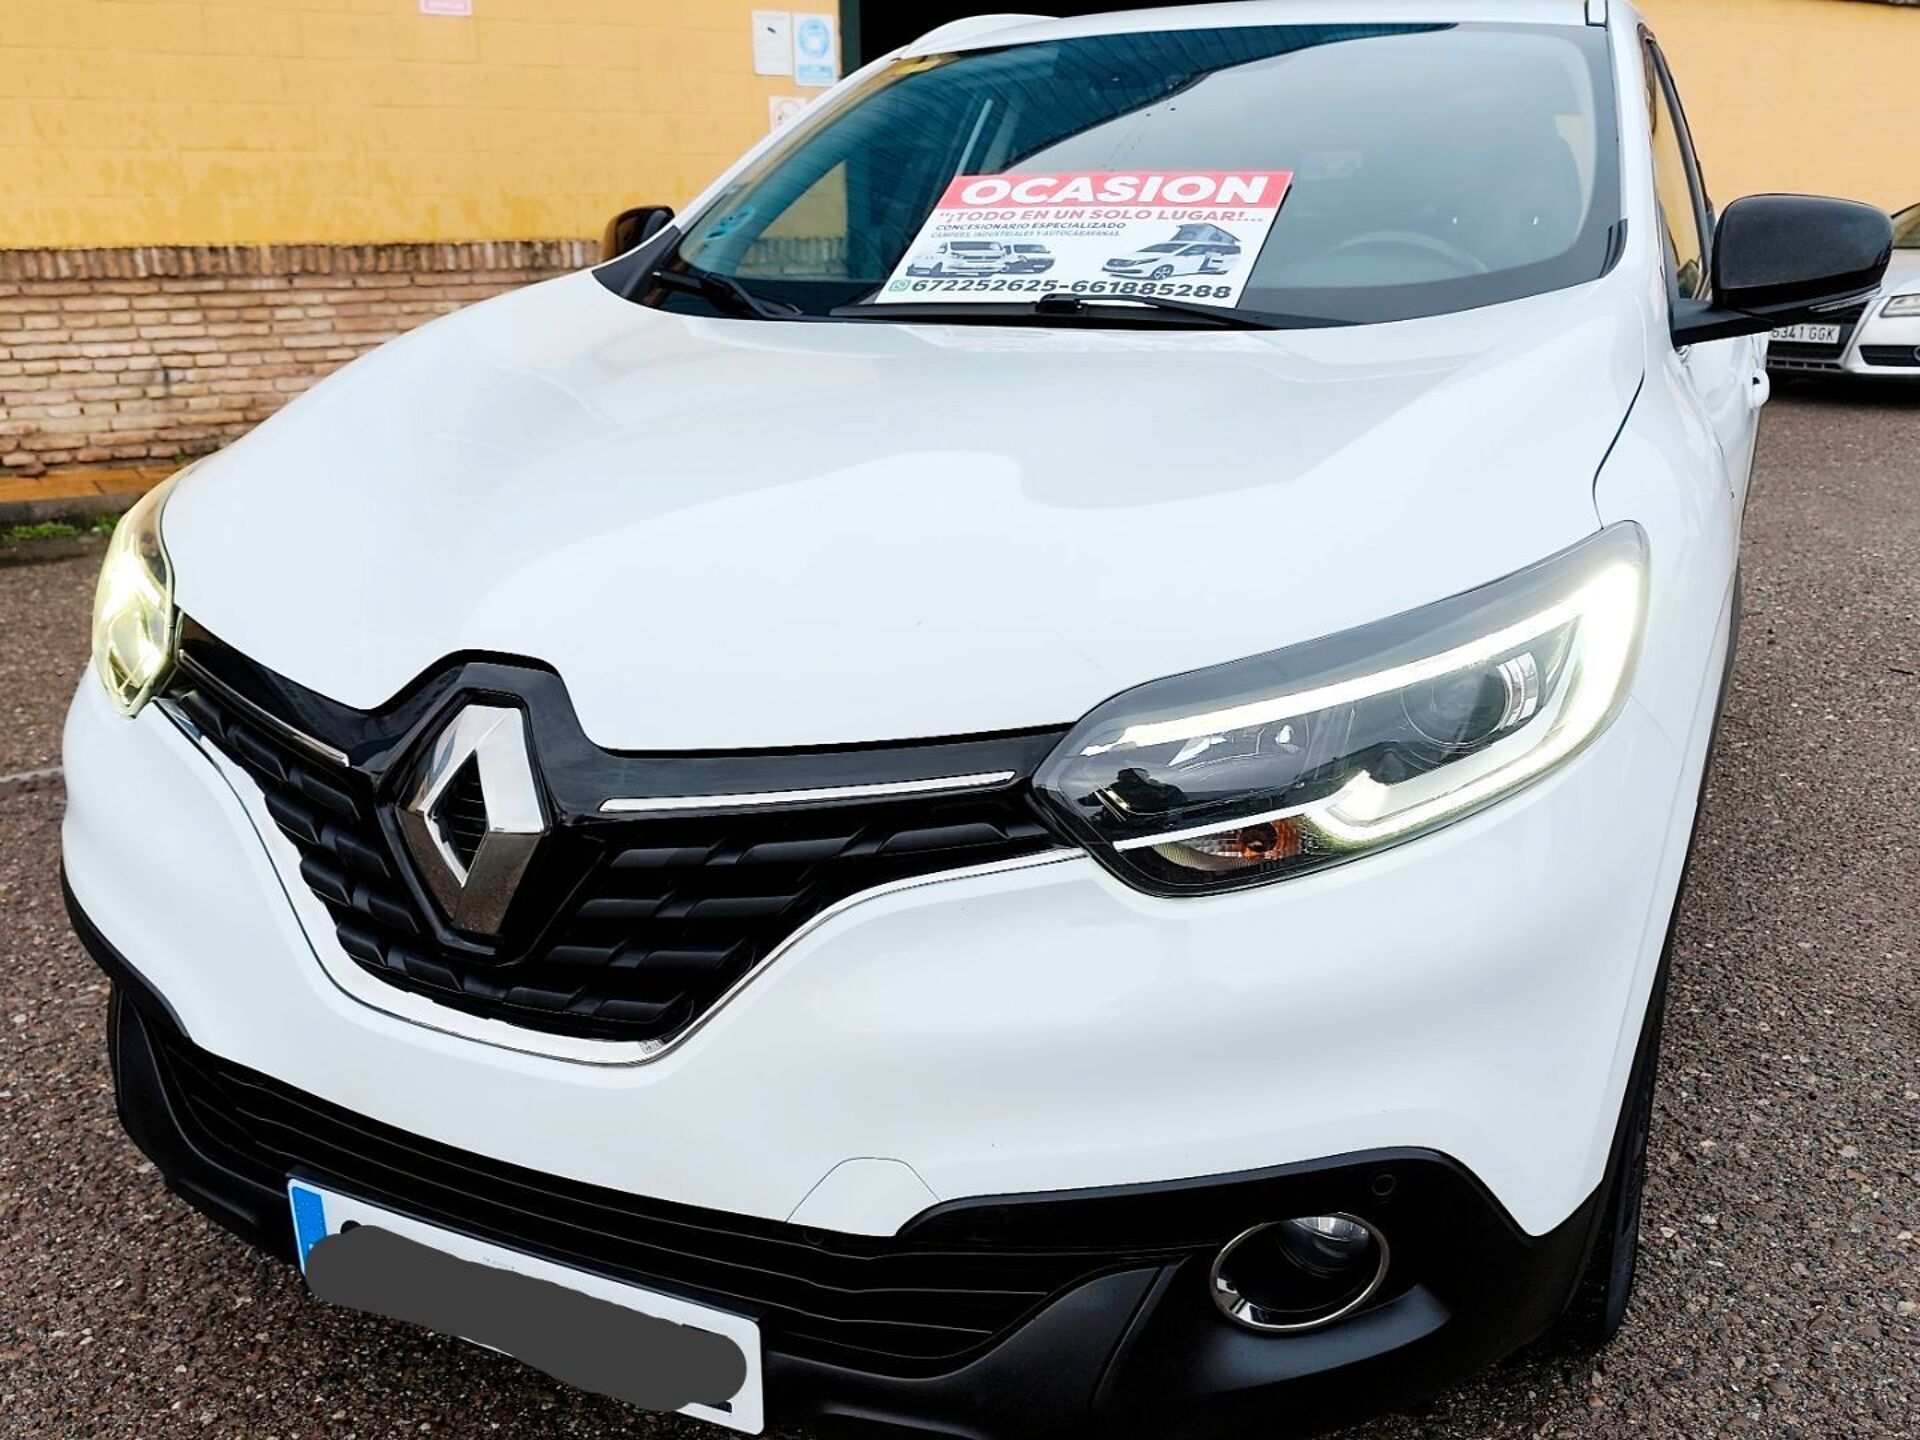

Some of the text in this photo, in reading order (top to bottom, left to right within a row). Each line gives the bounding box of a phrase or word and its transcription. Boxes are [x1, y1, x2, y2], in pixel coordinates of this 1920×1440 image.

[961, 176, 1268, 205] OCASION
[1020, 210, 1049, 220] EN
[1054, 210, 1084, 220] UN
[1089, 209, 1151, 220] SOLO
[936, 223, 1030, 231] CONCESIONARIO
[911, 279, 1232, 299] 672252625-661885288
[1808, 326, 1836, 341] GGK
